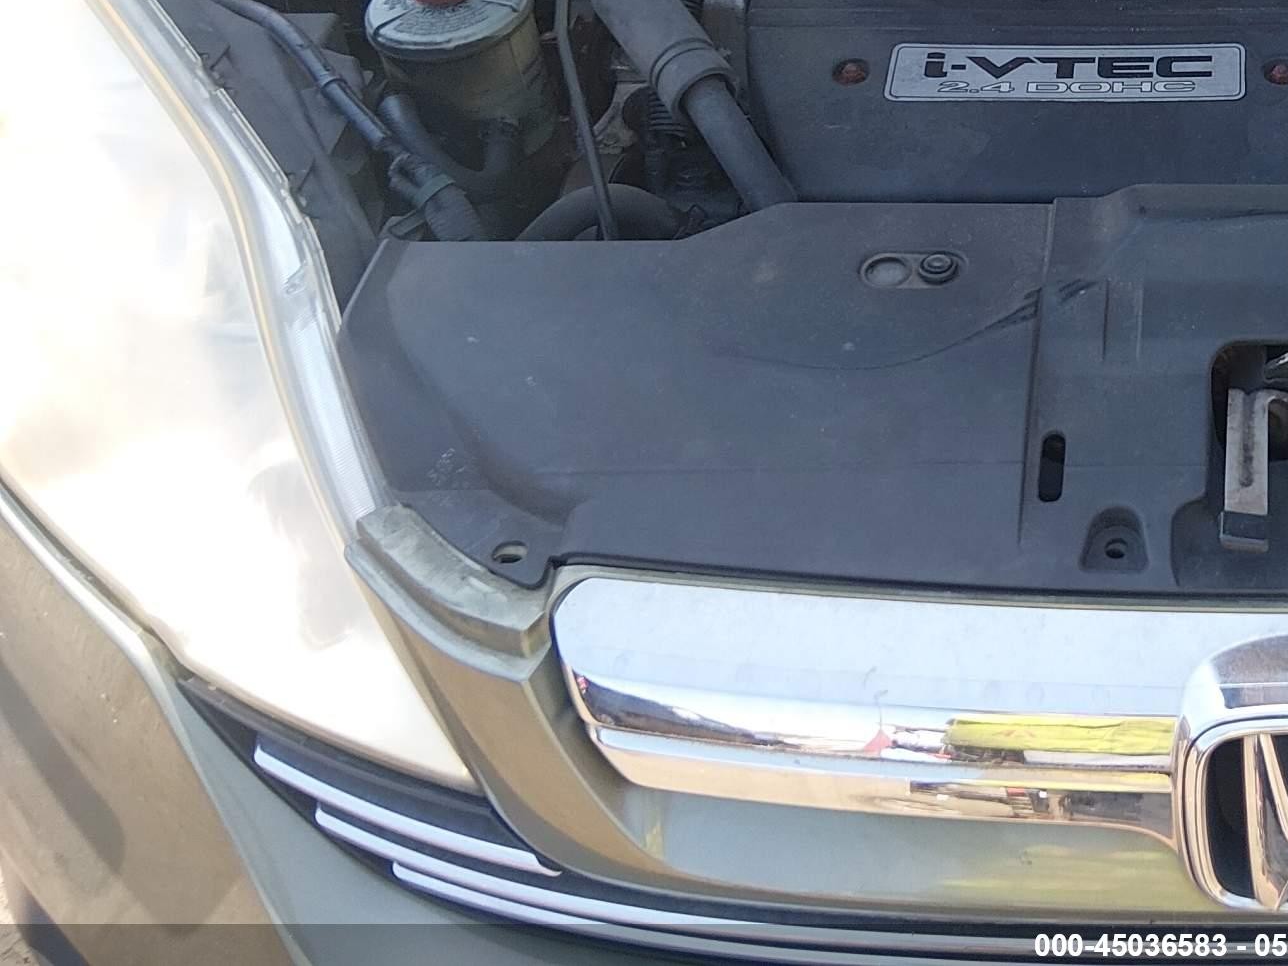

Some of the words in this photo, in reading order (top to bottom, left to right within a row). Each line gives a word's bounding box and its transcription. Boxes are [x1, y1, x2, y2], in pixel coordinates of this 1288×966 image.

[924, 51, 1213, 79] i-VTEC
[937, 80, 1016, 94] 2.4
[1026, 80, 1196, 94] DOHC
